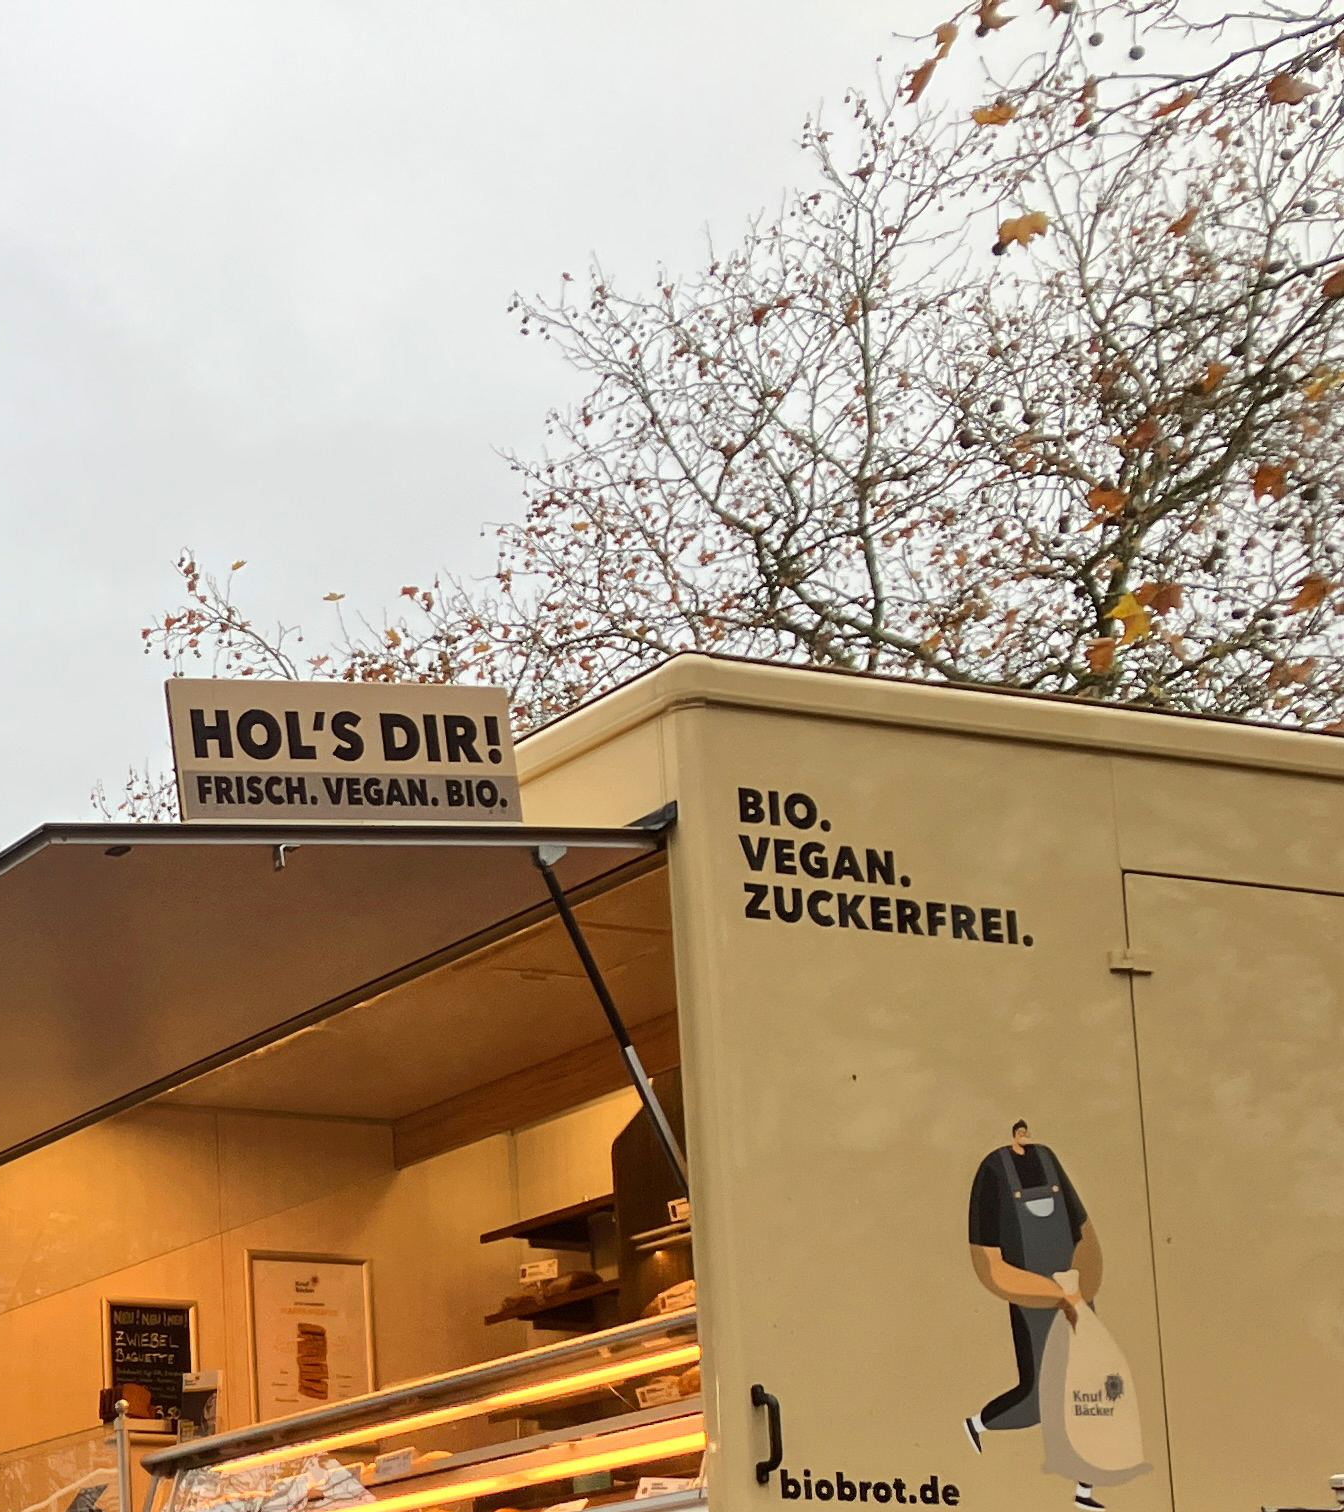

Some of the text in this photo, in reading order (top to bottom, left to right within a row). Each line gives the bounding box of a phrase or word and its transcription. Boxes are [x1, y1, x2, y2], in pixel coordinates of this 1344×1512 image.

[190, 708, 503, 765] HOL'S DIR!
[197, 775, 509, 808] FRISCH. VEGAN. BIO.
[737, 786, 832, 833] BIO.
[738, 833, 912, 888] VEGAN.
[743, 881, 1035, 948] ZUCKERFREI.
[114, 1330, 180, 1349] ZWIEBEL
[1074, 1403, 1114, 1417] Bäcker
[779, 1468, 961, 1507] biobrot.de
